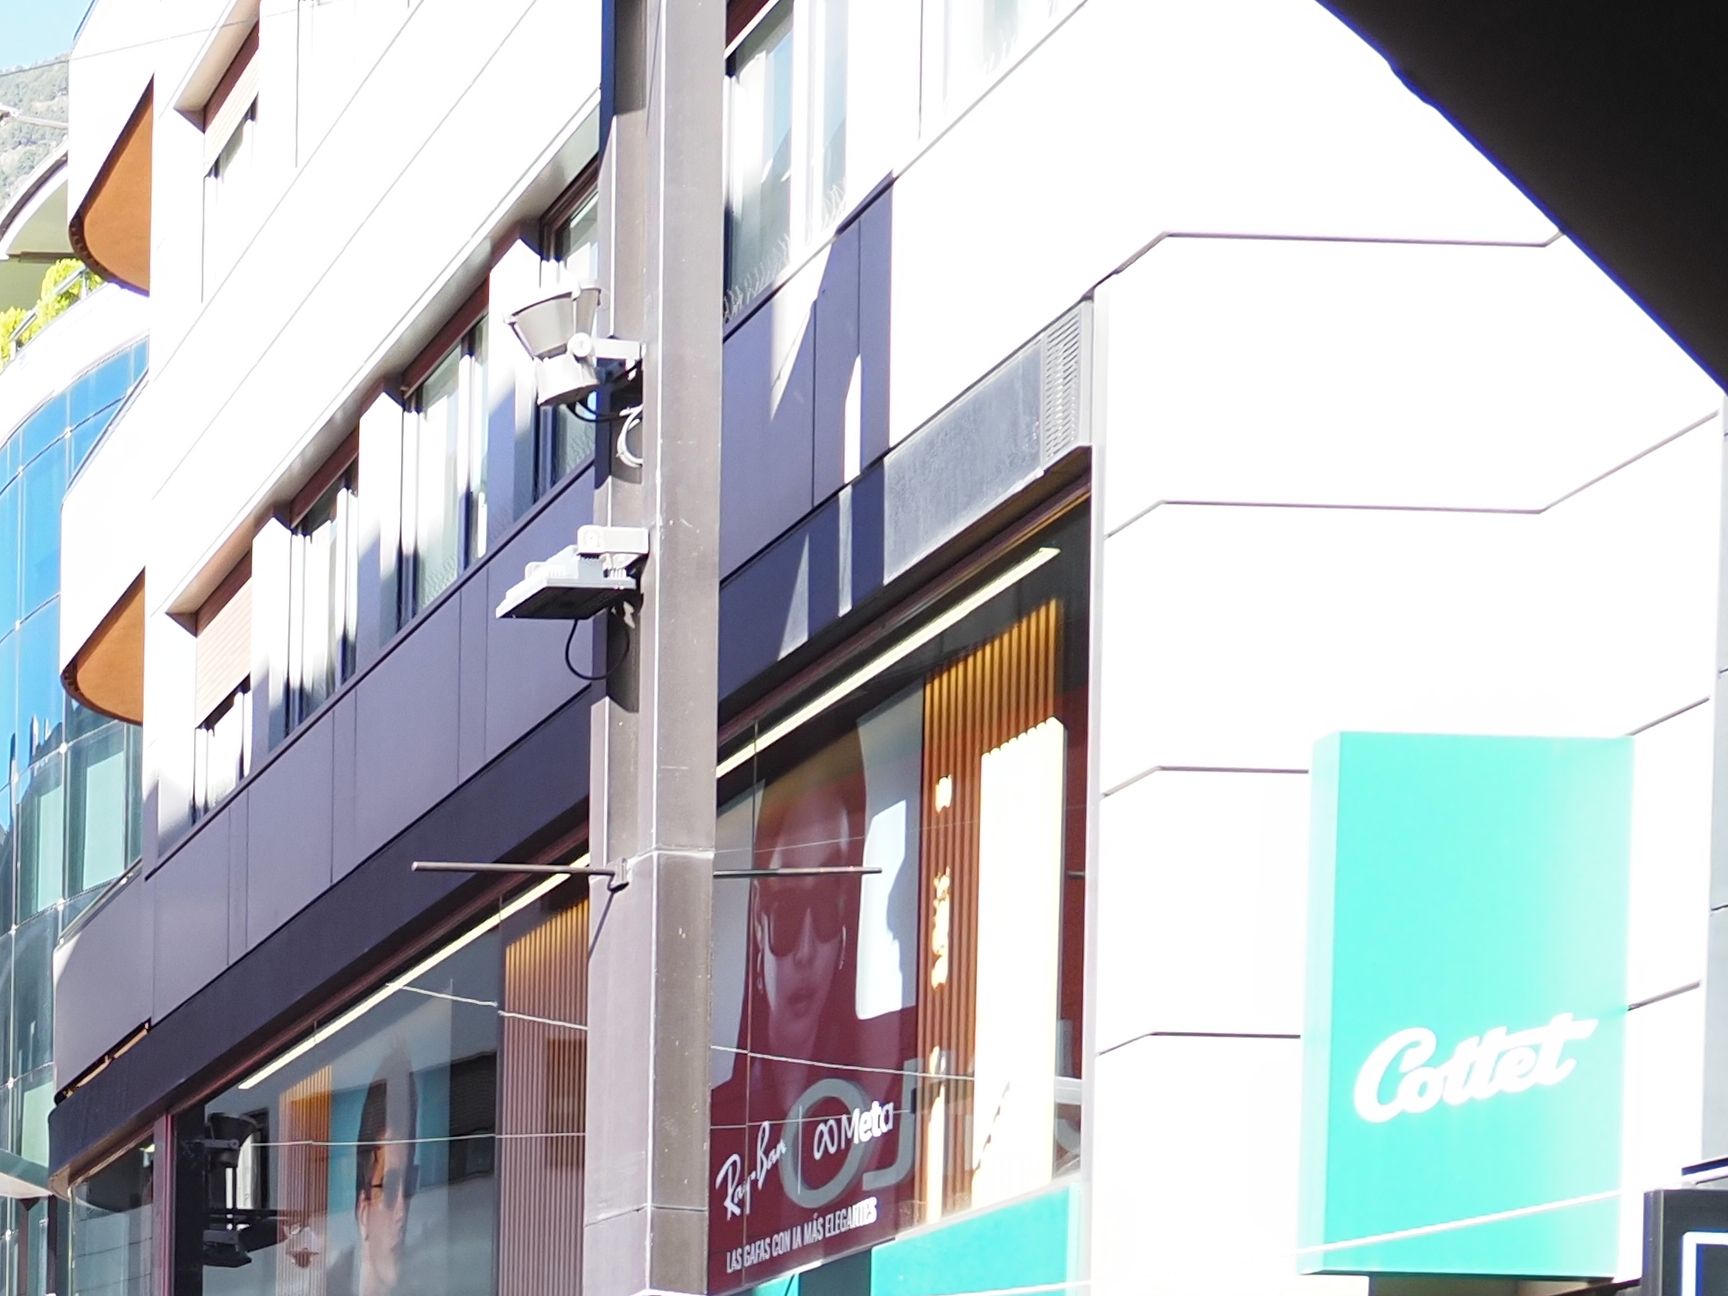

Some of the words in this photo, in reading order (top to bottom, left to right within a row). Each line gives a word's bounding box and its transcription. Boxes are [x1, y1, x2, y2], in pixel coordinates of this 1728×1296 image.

[1353, 1012, 1599, 1124] Cottet
[841, 1100, 895, 1150] Meta
[726, 1250, 743, 1273] LAS
[744, 1239, 771, 1267] GAFAS
[771, 1229, 791, 1257] CON
[803, 1212, 824, 1247] MÁS
